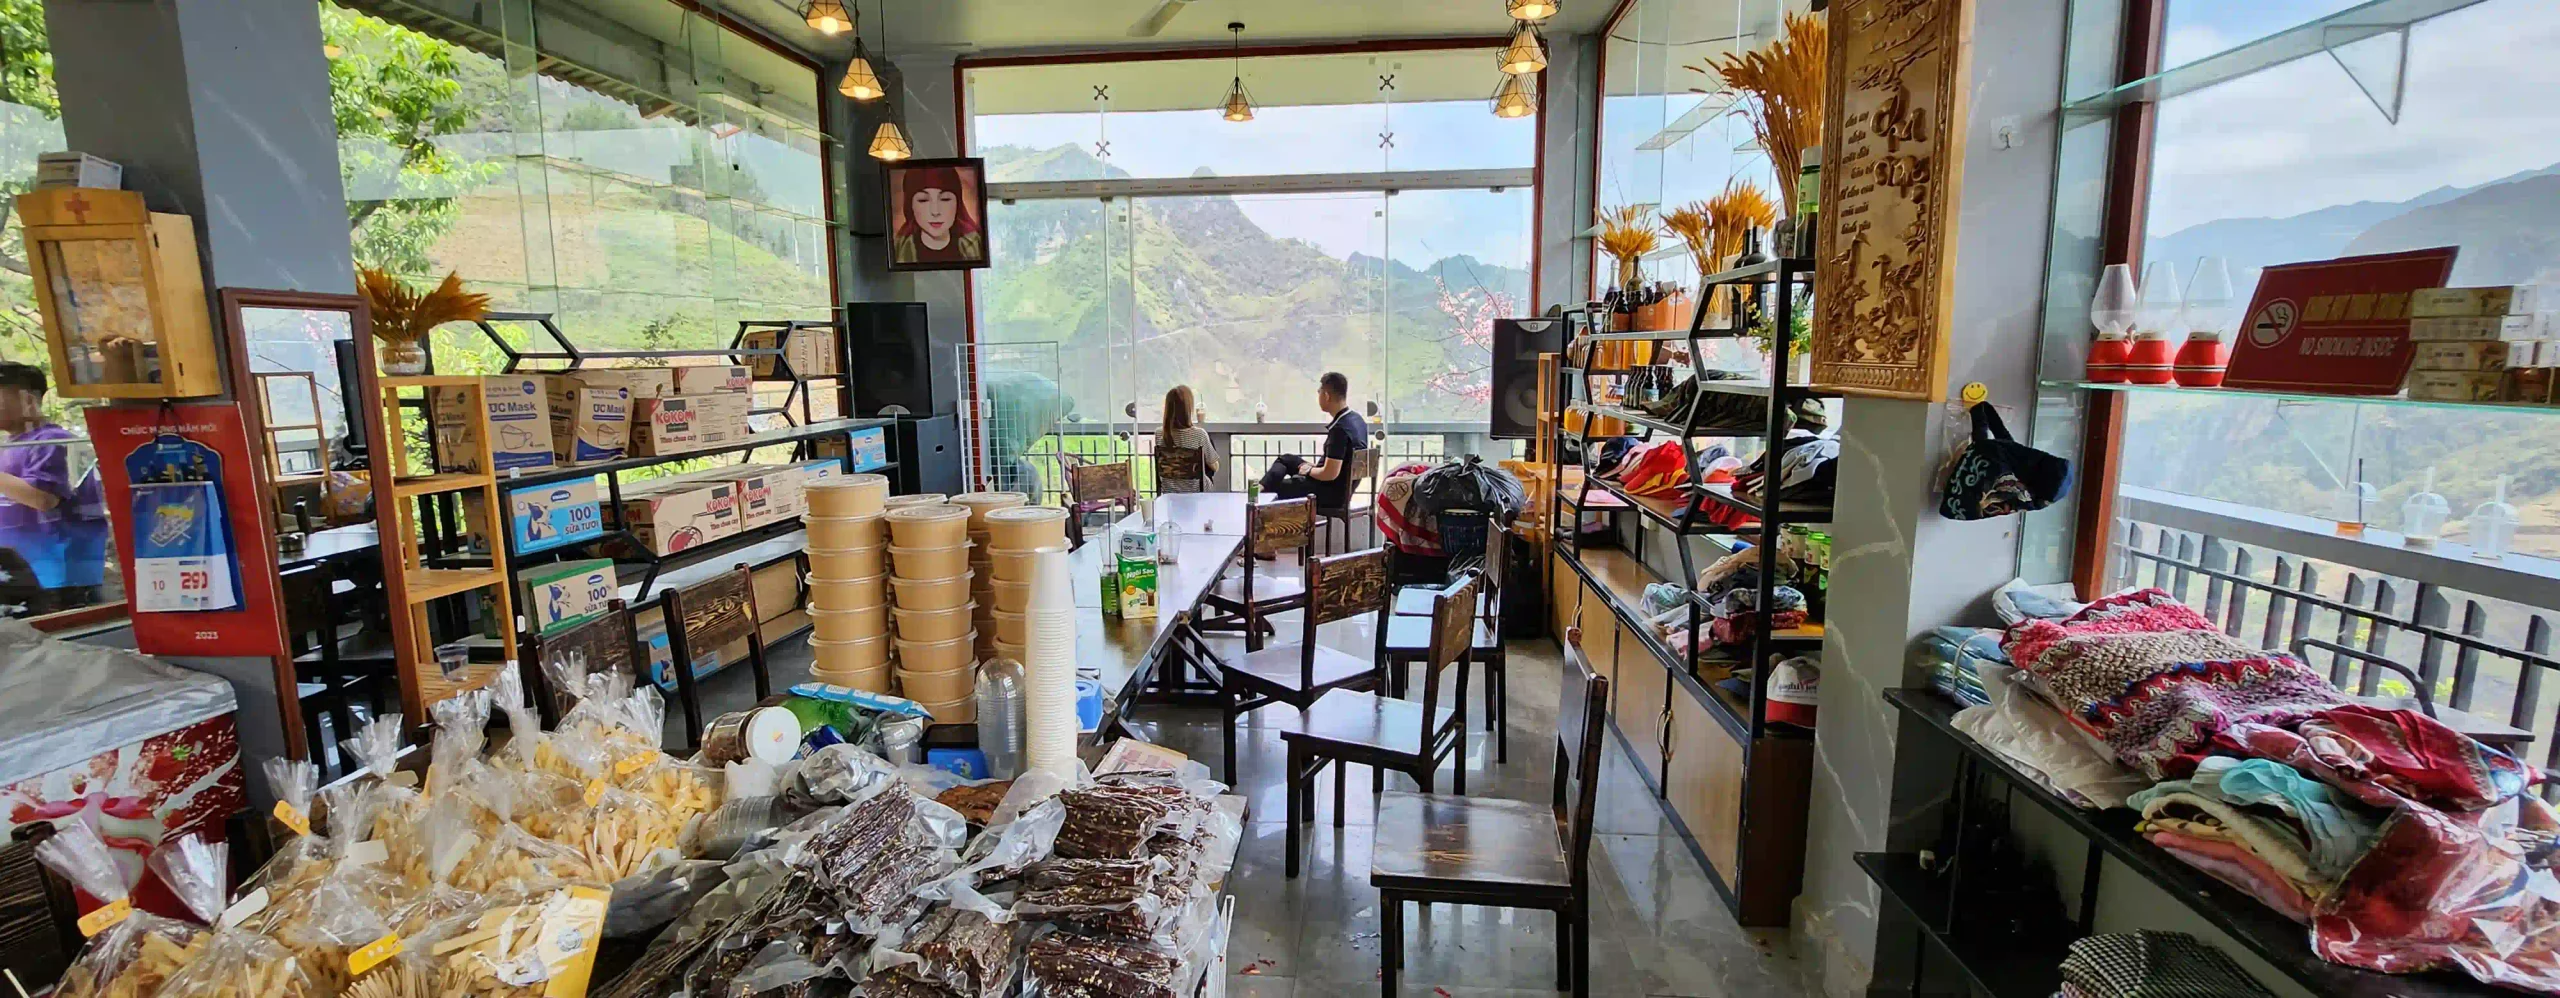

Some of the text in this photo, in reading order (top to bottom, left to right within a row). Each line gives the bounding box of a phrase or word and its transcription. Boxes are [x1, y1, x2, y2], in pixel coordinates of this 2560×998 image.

[2299, 337, 2399, 357] NO SMOKING INSIDE
[507, 401, 537, 412] Mask
[606, 403, 627, 414] Mask
[655, 409, 697, 425] KOKOMI
[743, 486, 772, 502] KOKOMI
[705, 495, 738, 513] KOKOMI
[152, 580, 165, 590] 10
[195, 631, 219, 640] 2023
